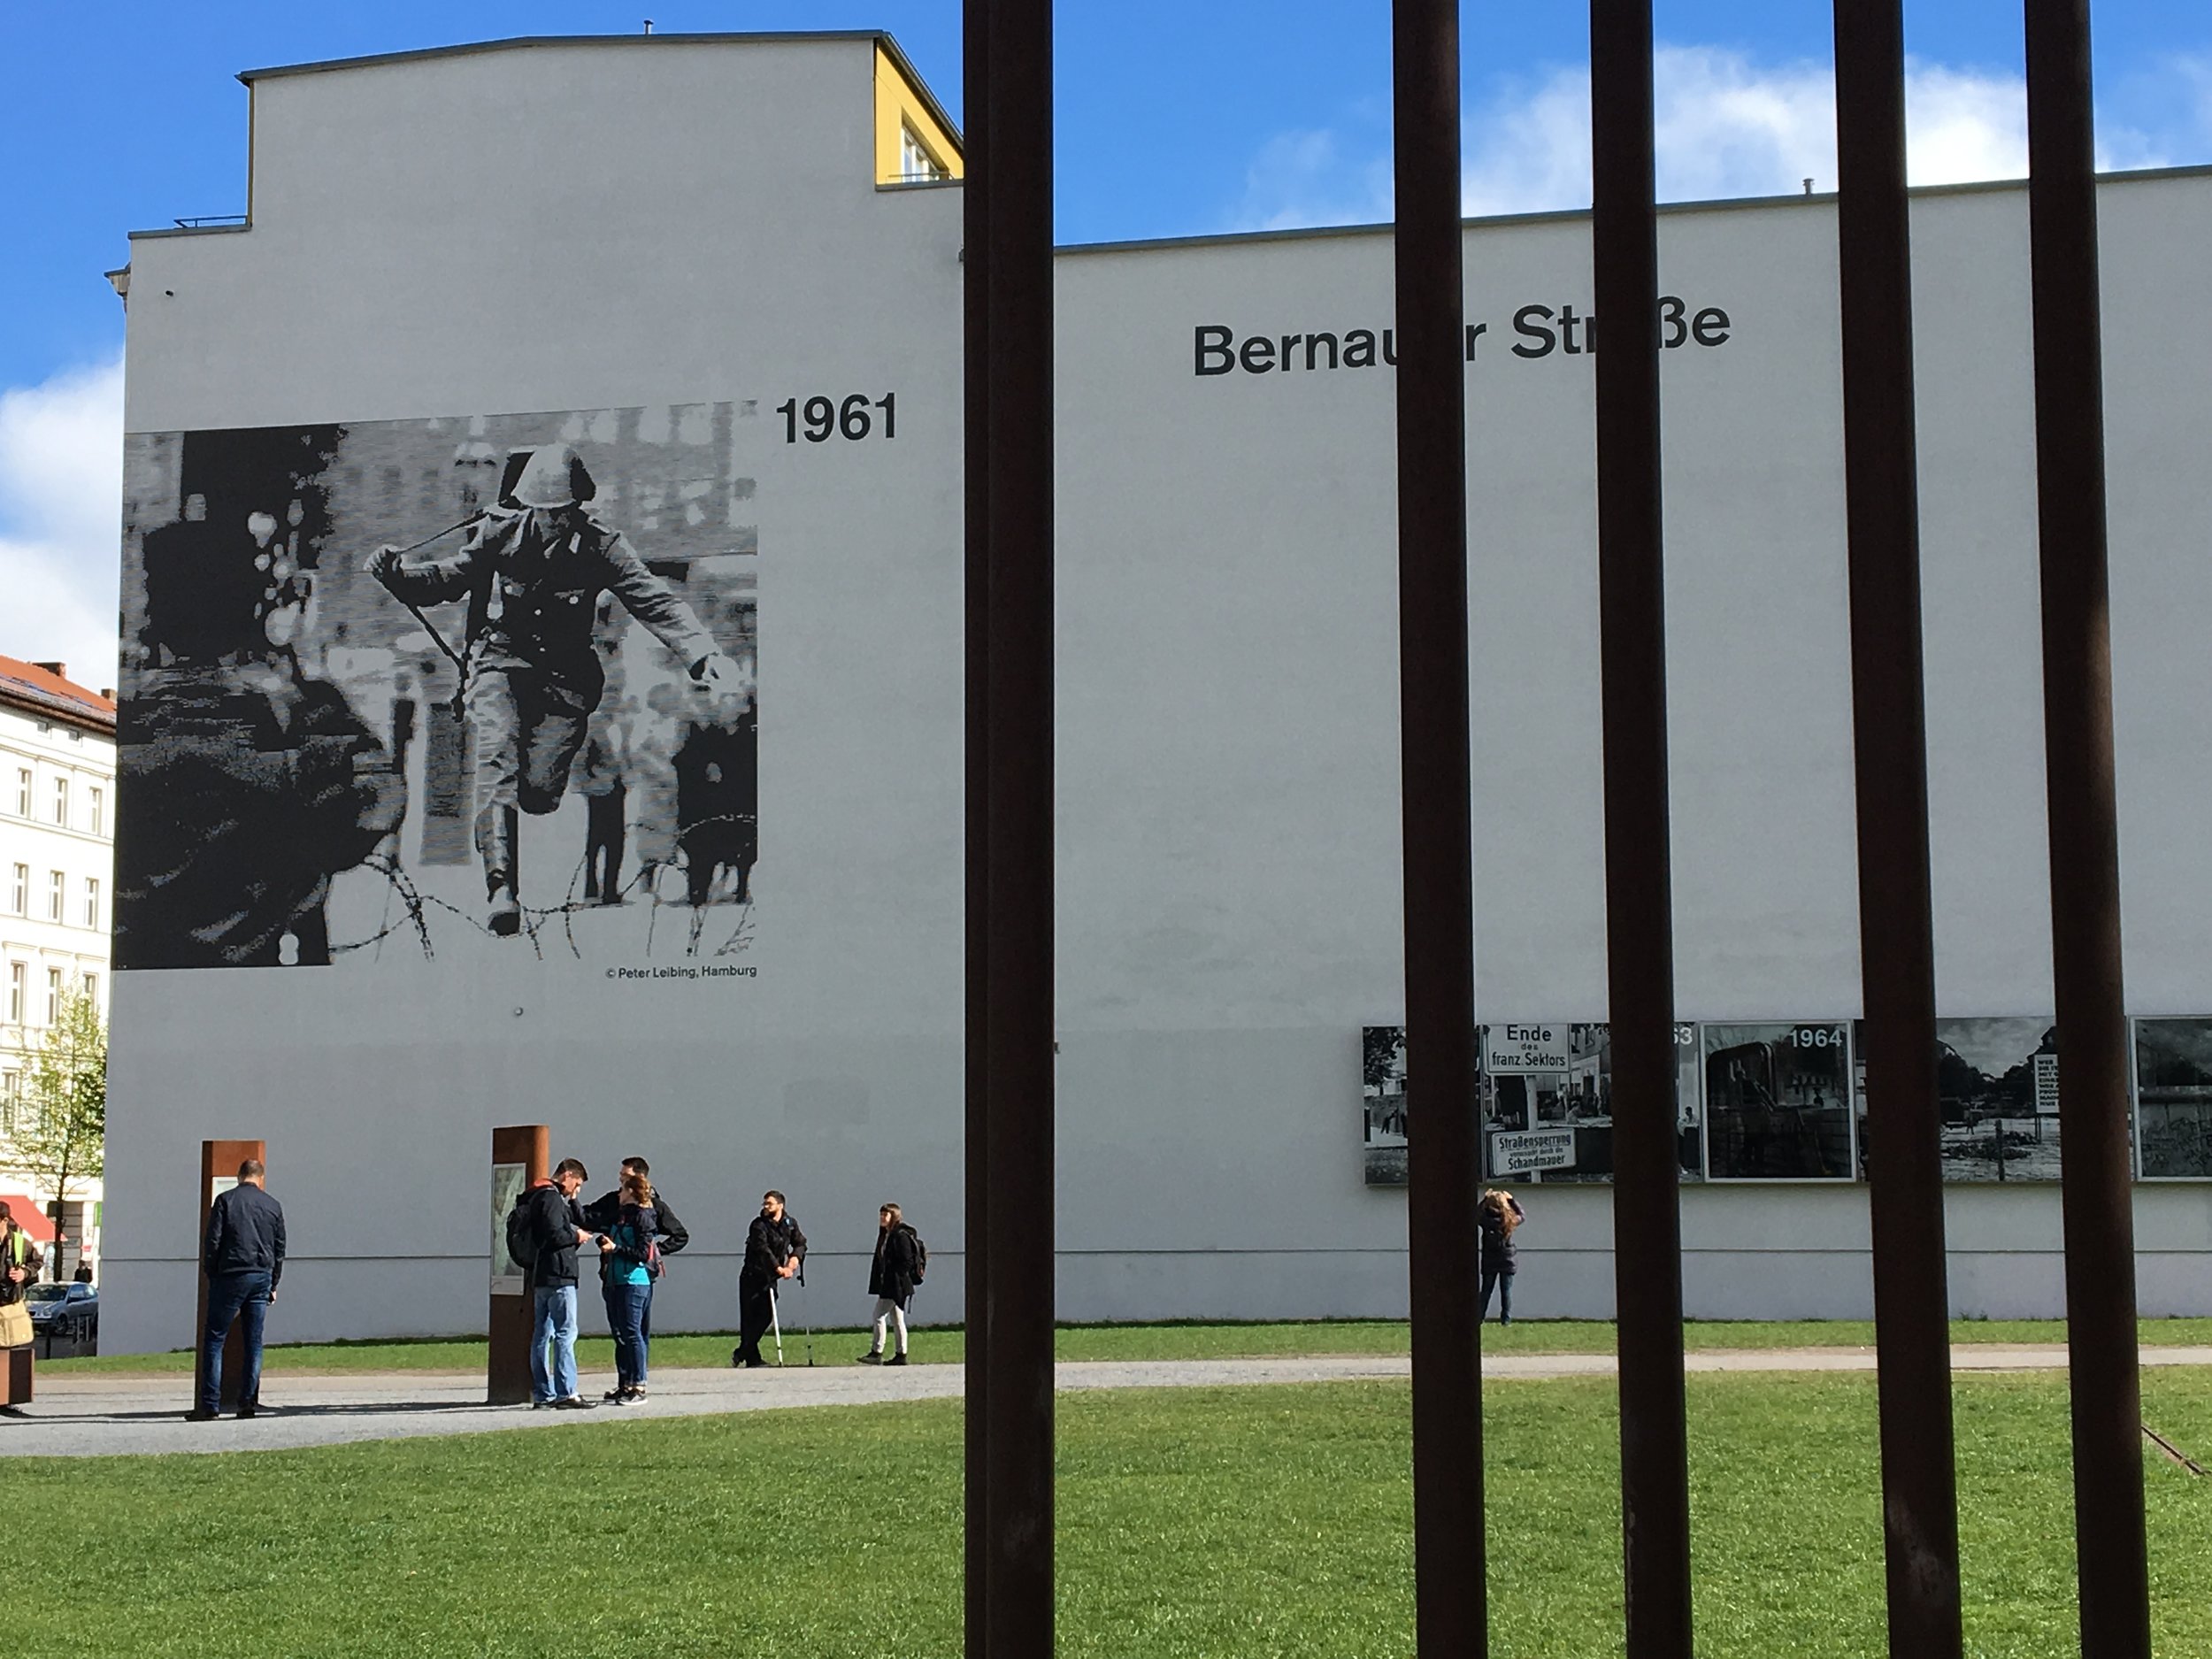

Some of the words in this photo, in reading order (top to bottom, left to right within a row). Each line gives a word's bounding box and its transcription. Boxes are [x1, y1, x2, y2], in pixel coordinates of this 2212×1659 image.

[1510, 296, 1731, 359] Strße
[776, 392, 895, 444] 1961
[618, 967, 650, 979] Peter
[652, 965, 700, 979] Leibing,
[702, 964, 757, 978] Hamburg
[1507, 1025, 1552, 1041] Ende
[1790, 1029, 1842, 1048] 1964
[1525, 1052, 1565, 1066] Sektors
[1499, 1134, 1571, 1149] Straßensperrung
[1508, 1155, 1565, 1170] Schandmauer
